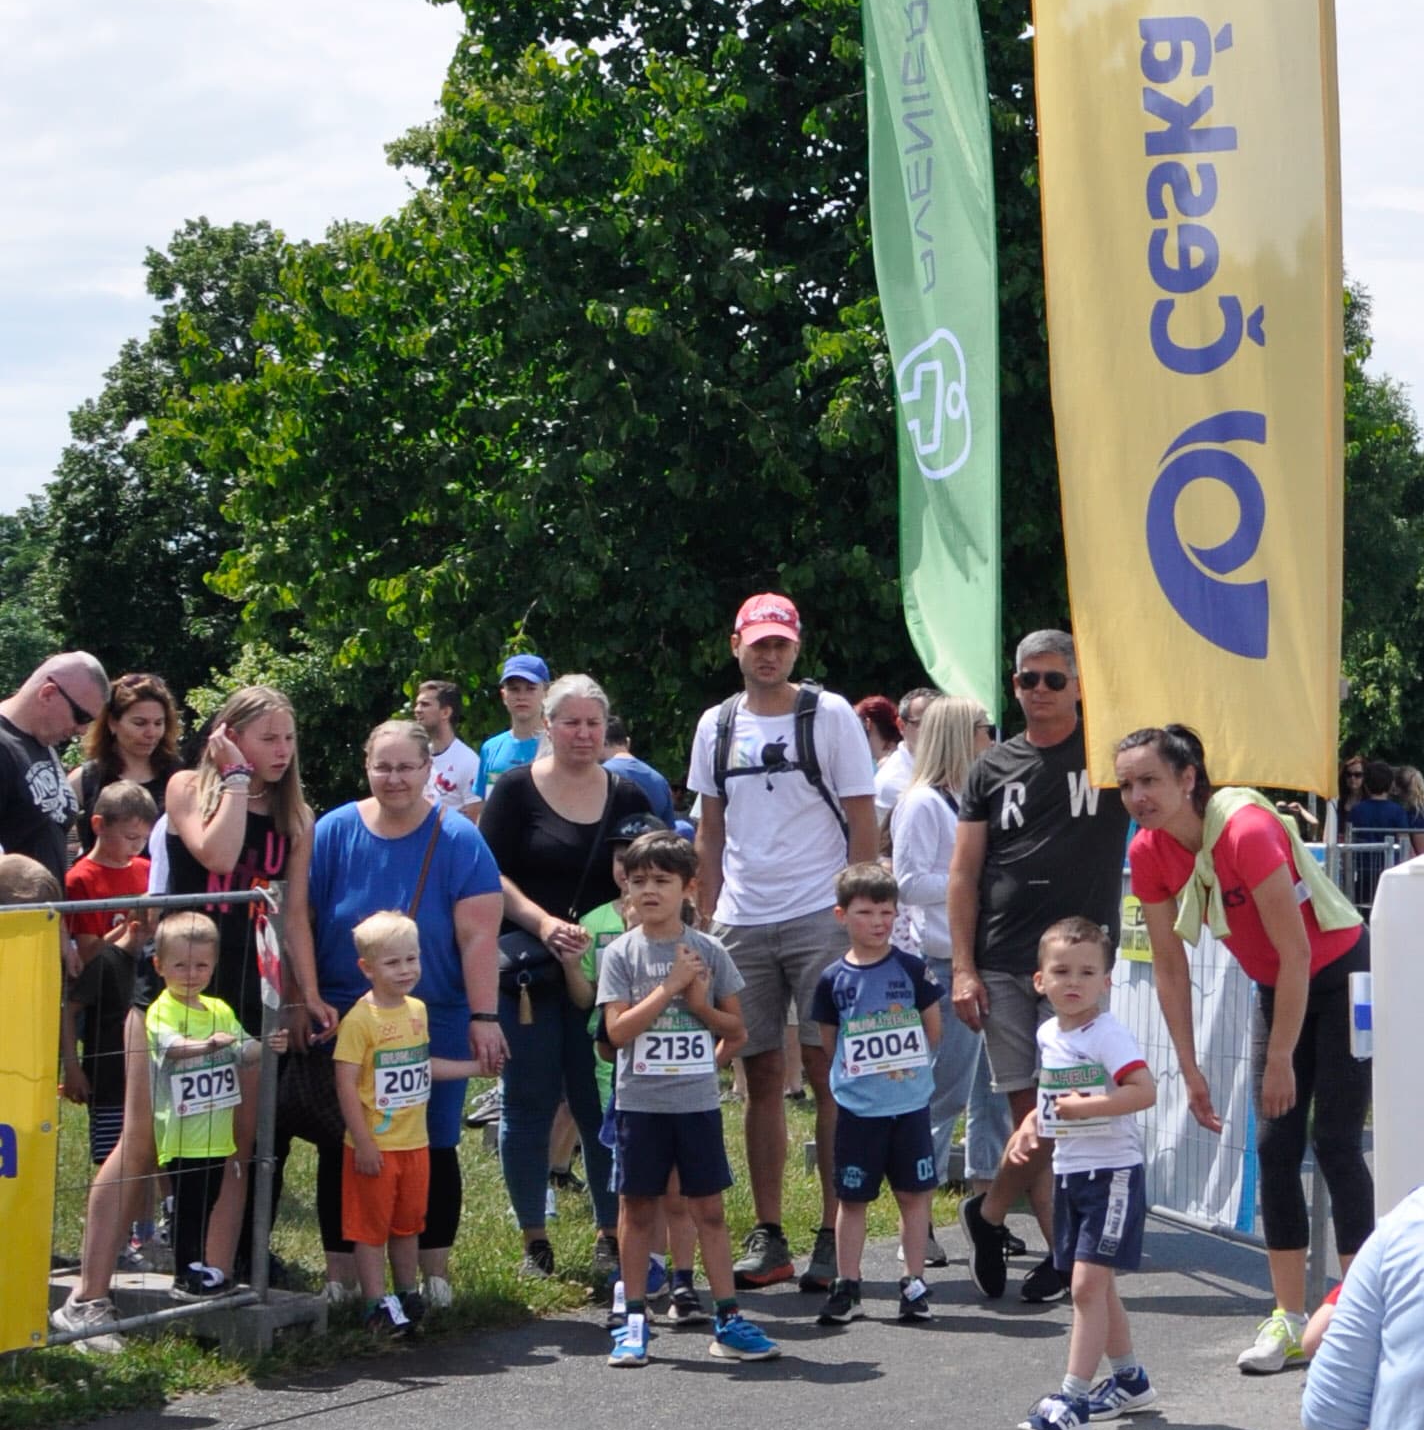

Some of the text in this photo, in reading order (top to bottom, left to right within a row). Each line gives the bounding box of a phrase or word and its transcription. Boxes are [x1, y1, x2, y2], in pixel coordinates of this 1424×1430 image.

[645, 1035, 705, 1060] 2136
[851, 1031, 920, 1062] 2004
[180, 1068, 235, 1101] 2079
[383, 1065, 430, 1094] 2076
